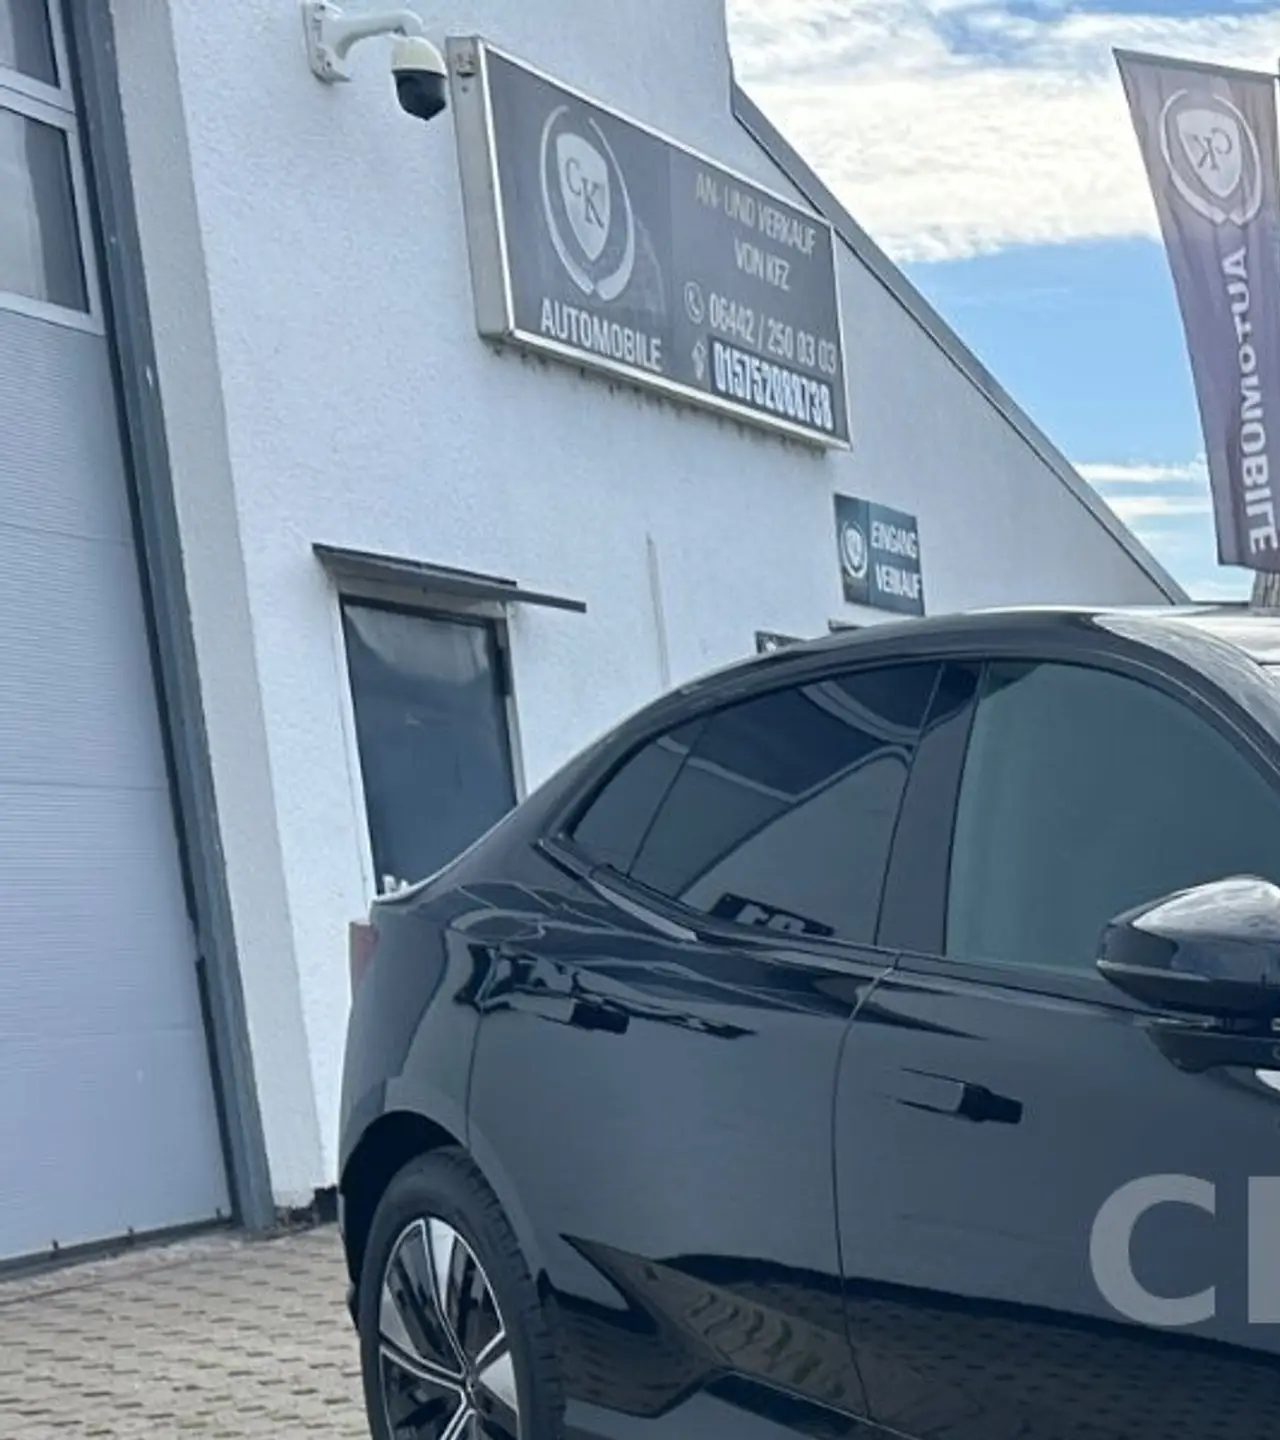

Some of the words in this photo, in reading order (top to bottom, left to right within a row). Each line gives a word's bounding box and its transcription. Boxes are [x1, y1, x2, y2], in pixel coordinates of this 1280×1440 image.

[565, 157, 605, 229] CK
[724, 185, 756, 229] UND
[757, 201, 816, 259] VERKAUF
[734, 237, 764, 281] VON
[765, 254, 791, 292] KFZ
[540, 297, 662, 372] AUTOMOBILE
